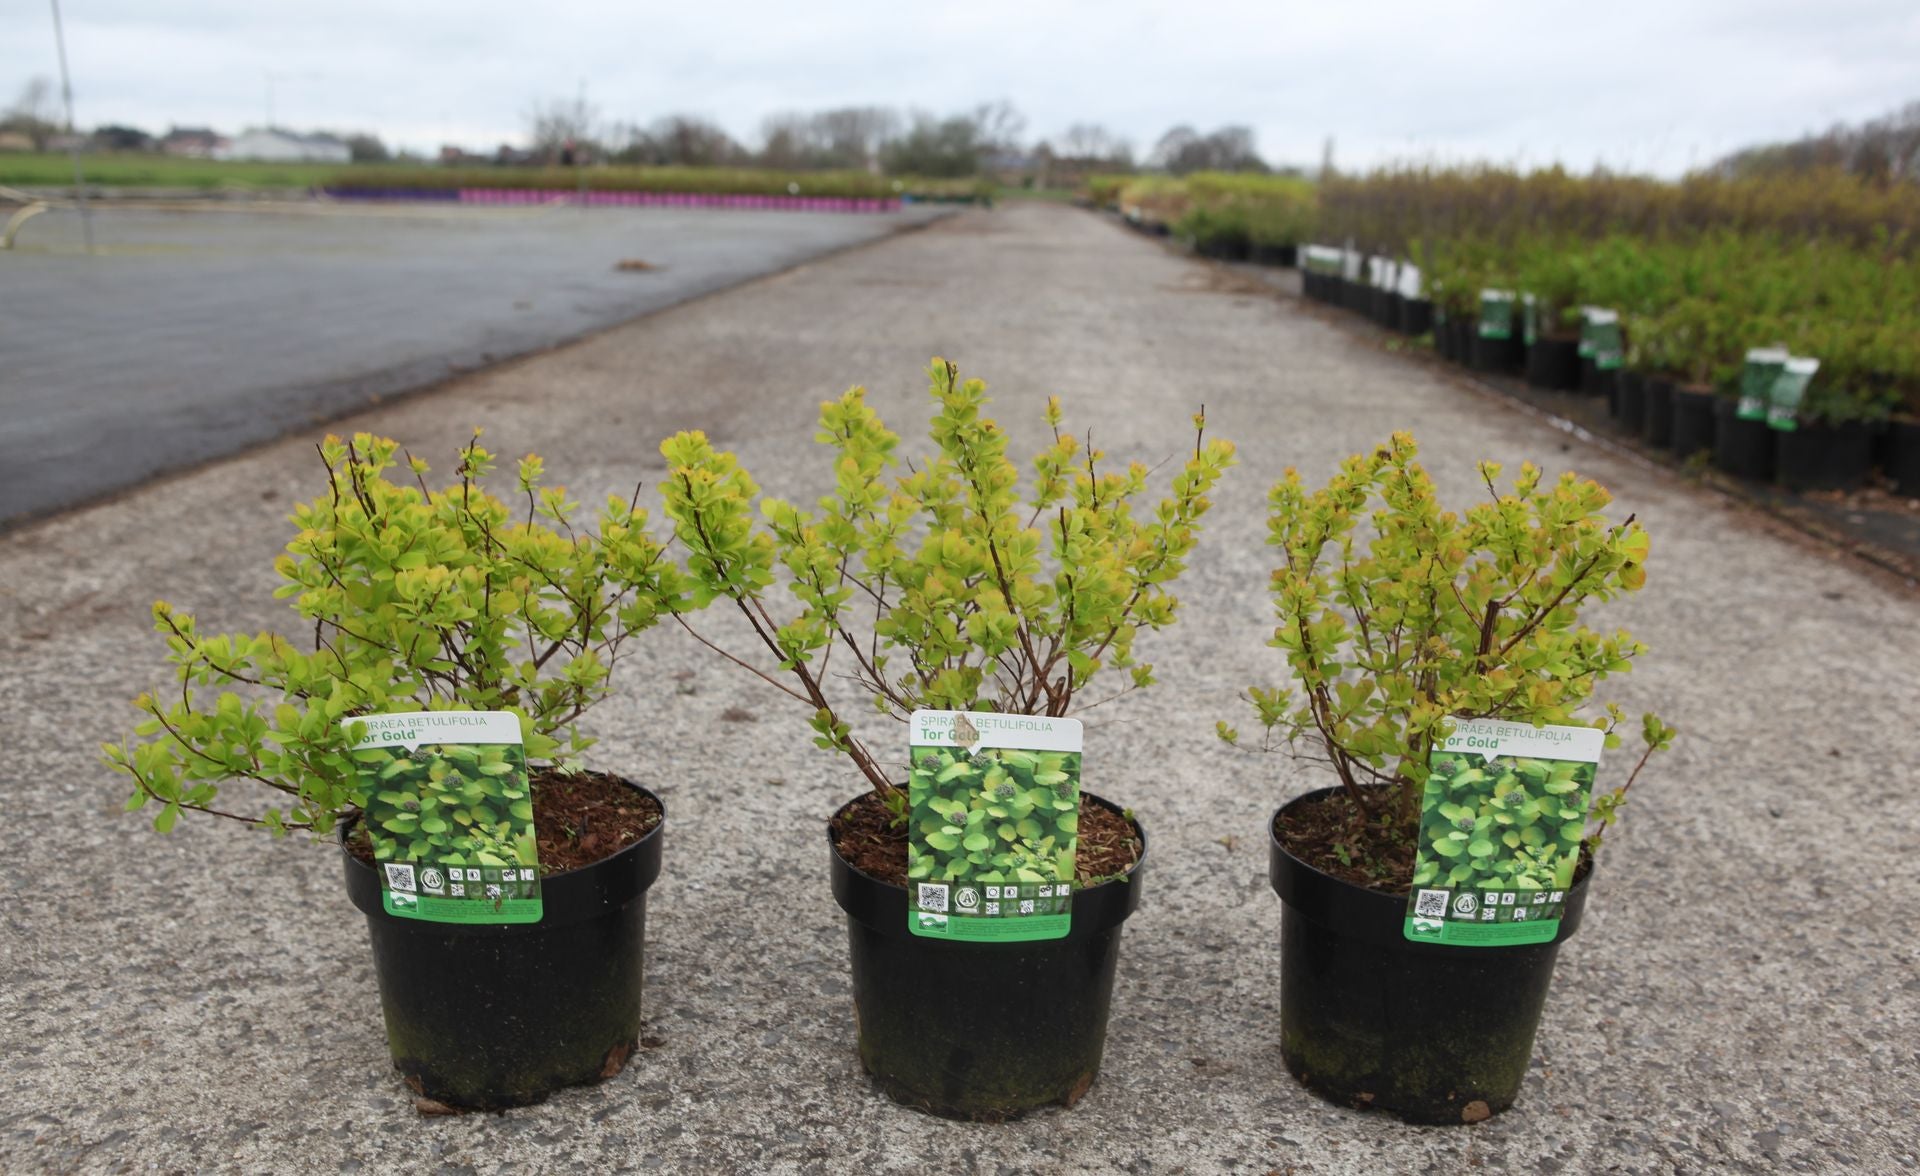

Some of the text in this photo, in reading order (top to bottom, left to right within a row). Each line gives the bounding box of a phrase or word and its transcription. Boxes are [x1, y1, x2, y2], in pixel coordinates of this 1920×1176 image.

[366, 716, 488, 731] IRAEA BETULIFOLIA
[975, 718, 1053, 732] BETULIFOLIA
[921, 728, 943, 740] Tor
[1455, 722, 1573, 741] IRAEA BETULIFOLIA
